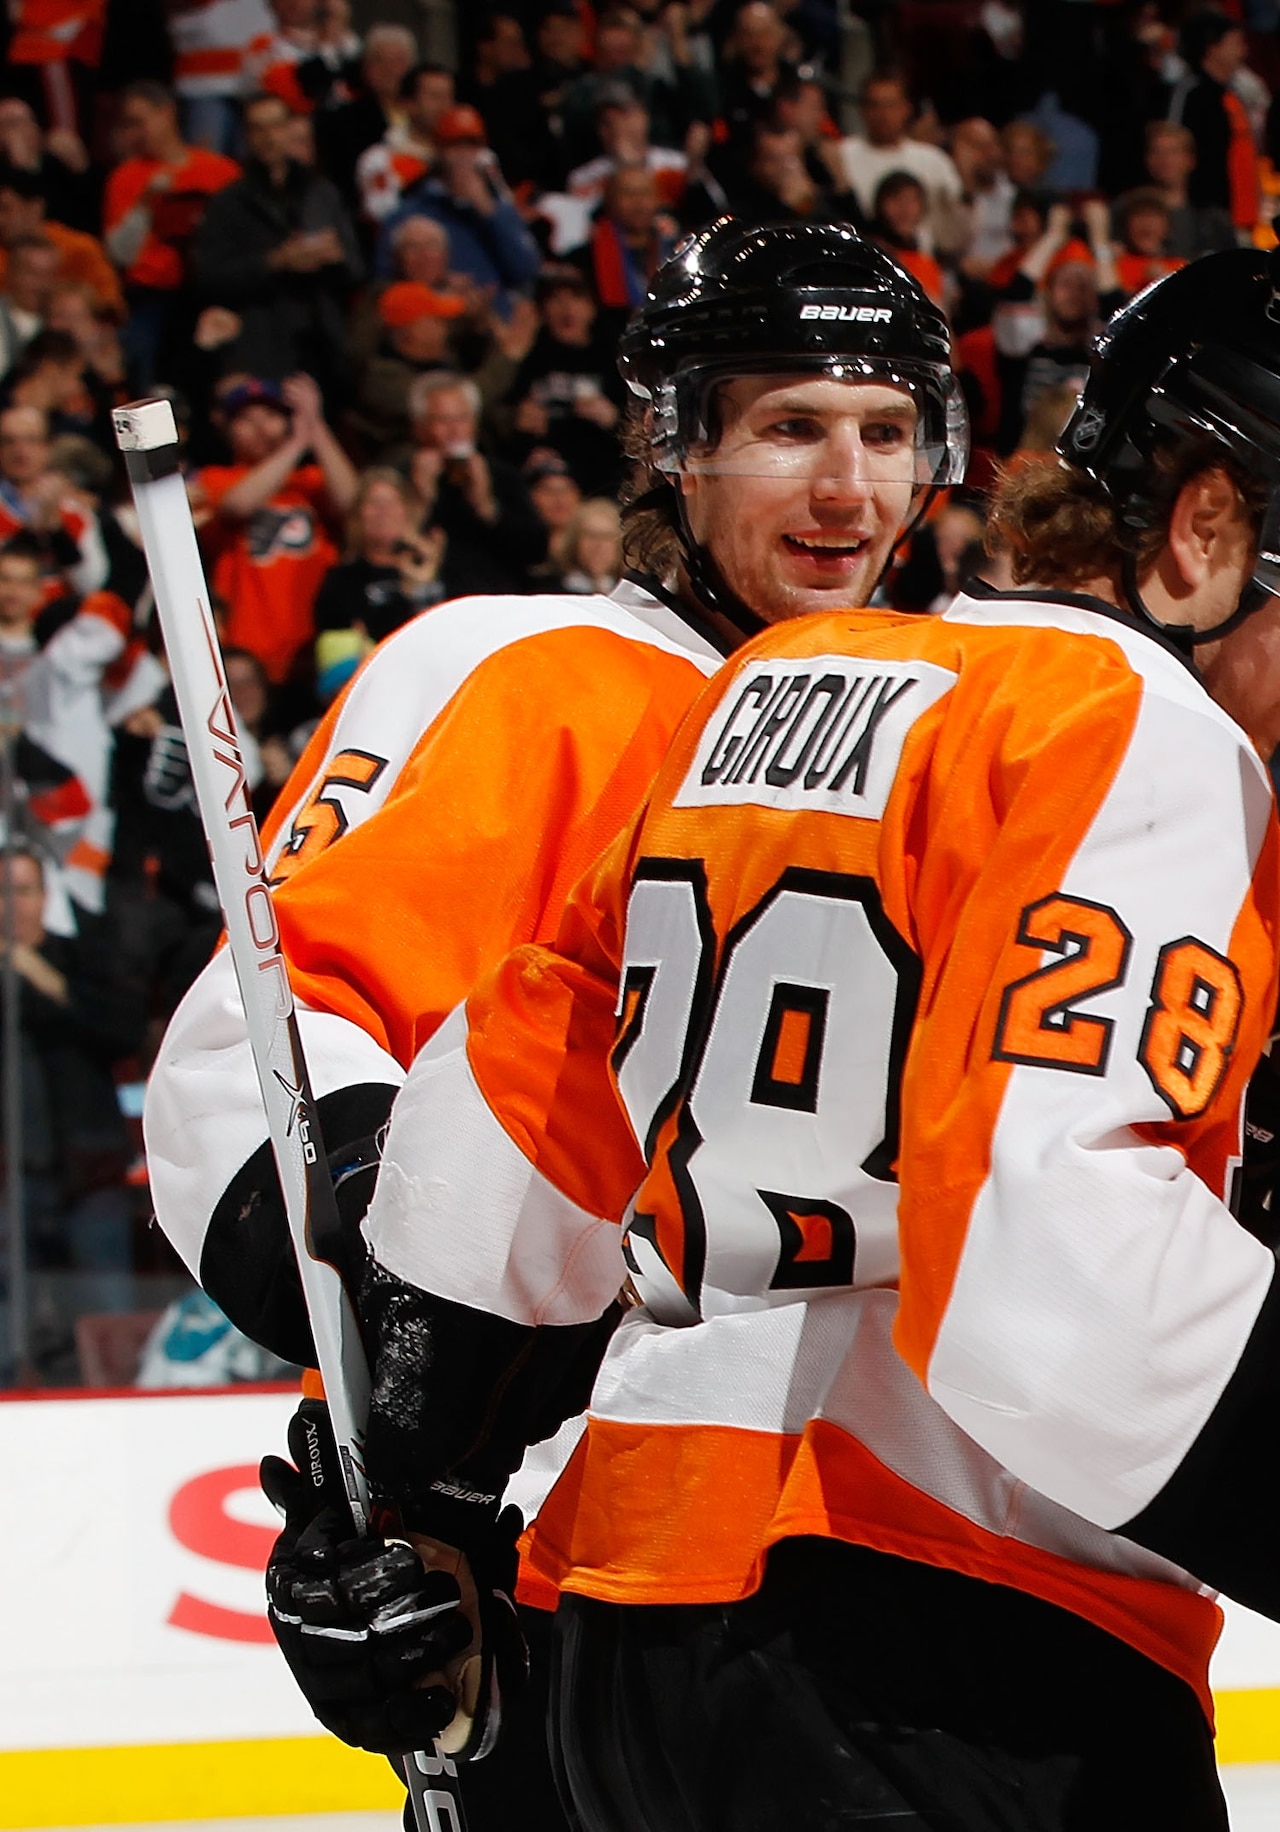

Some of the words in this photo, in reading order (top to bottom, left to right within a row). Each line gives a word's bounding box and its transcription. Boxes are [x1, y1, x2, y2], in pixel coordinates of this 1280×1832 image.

[800, 305, 893, 323] BAUER
[701, 674, 920, 796] GIROUX
[207, 684, 293, 1019] VAPOR
[611, 857, 924, 1322] 28
[990, 891, 1245, 1121] 28
[301, 1417, 325, 1487] GIROUX
